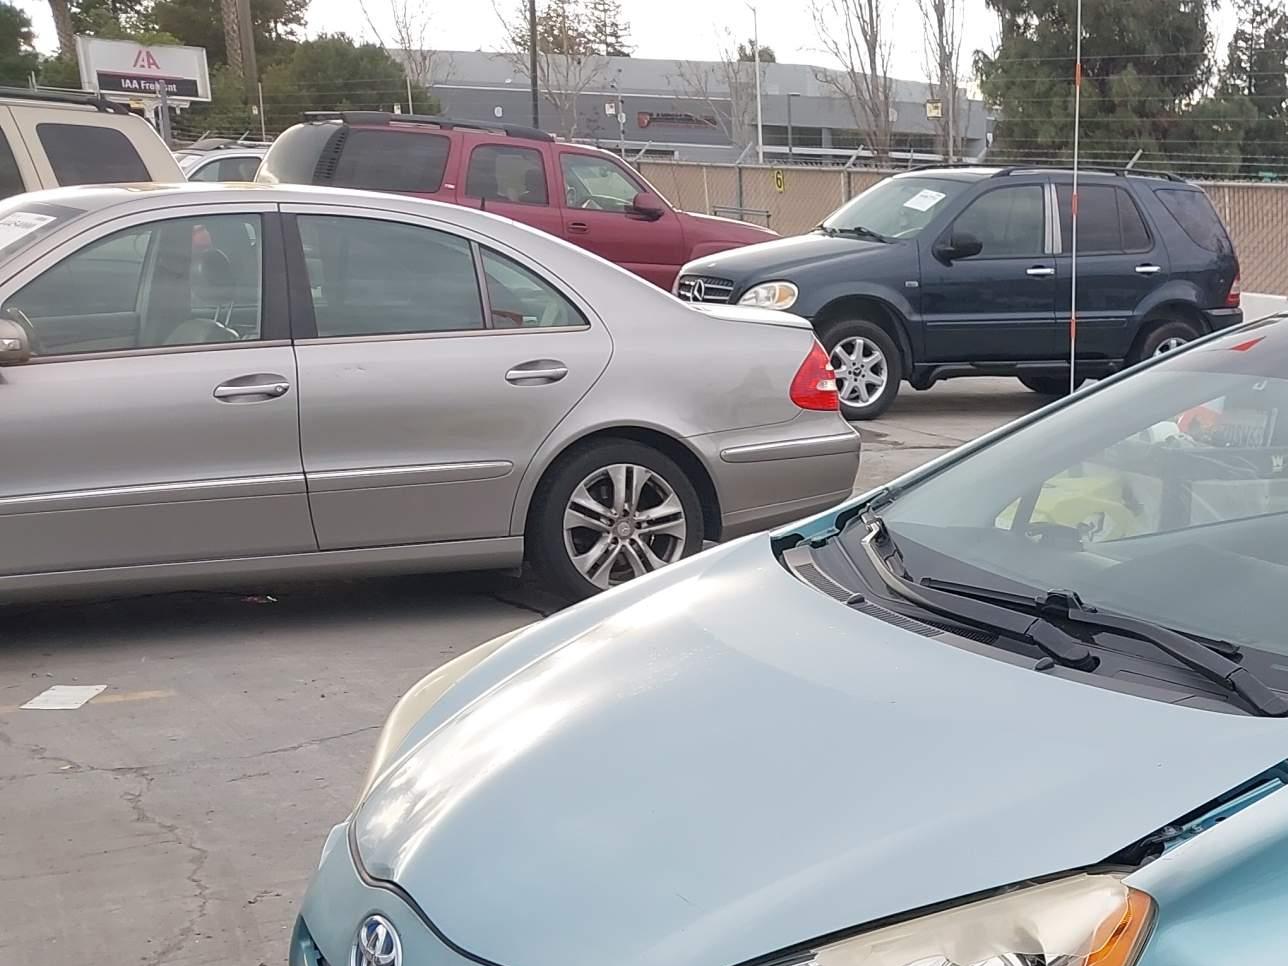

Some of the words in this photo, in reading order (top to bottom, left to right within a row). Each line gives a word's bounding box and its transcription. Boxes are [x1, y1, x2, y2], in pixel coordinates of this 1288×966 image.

[121, 78, 140, 90] IAA
[141, 80, 177, 93] Frent
[775, 170, 783, 189] 6
